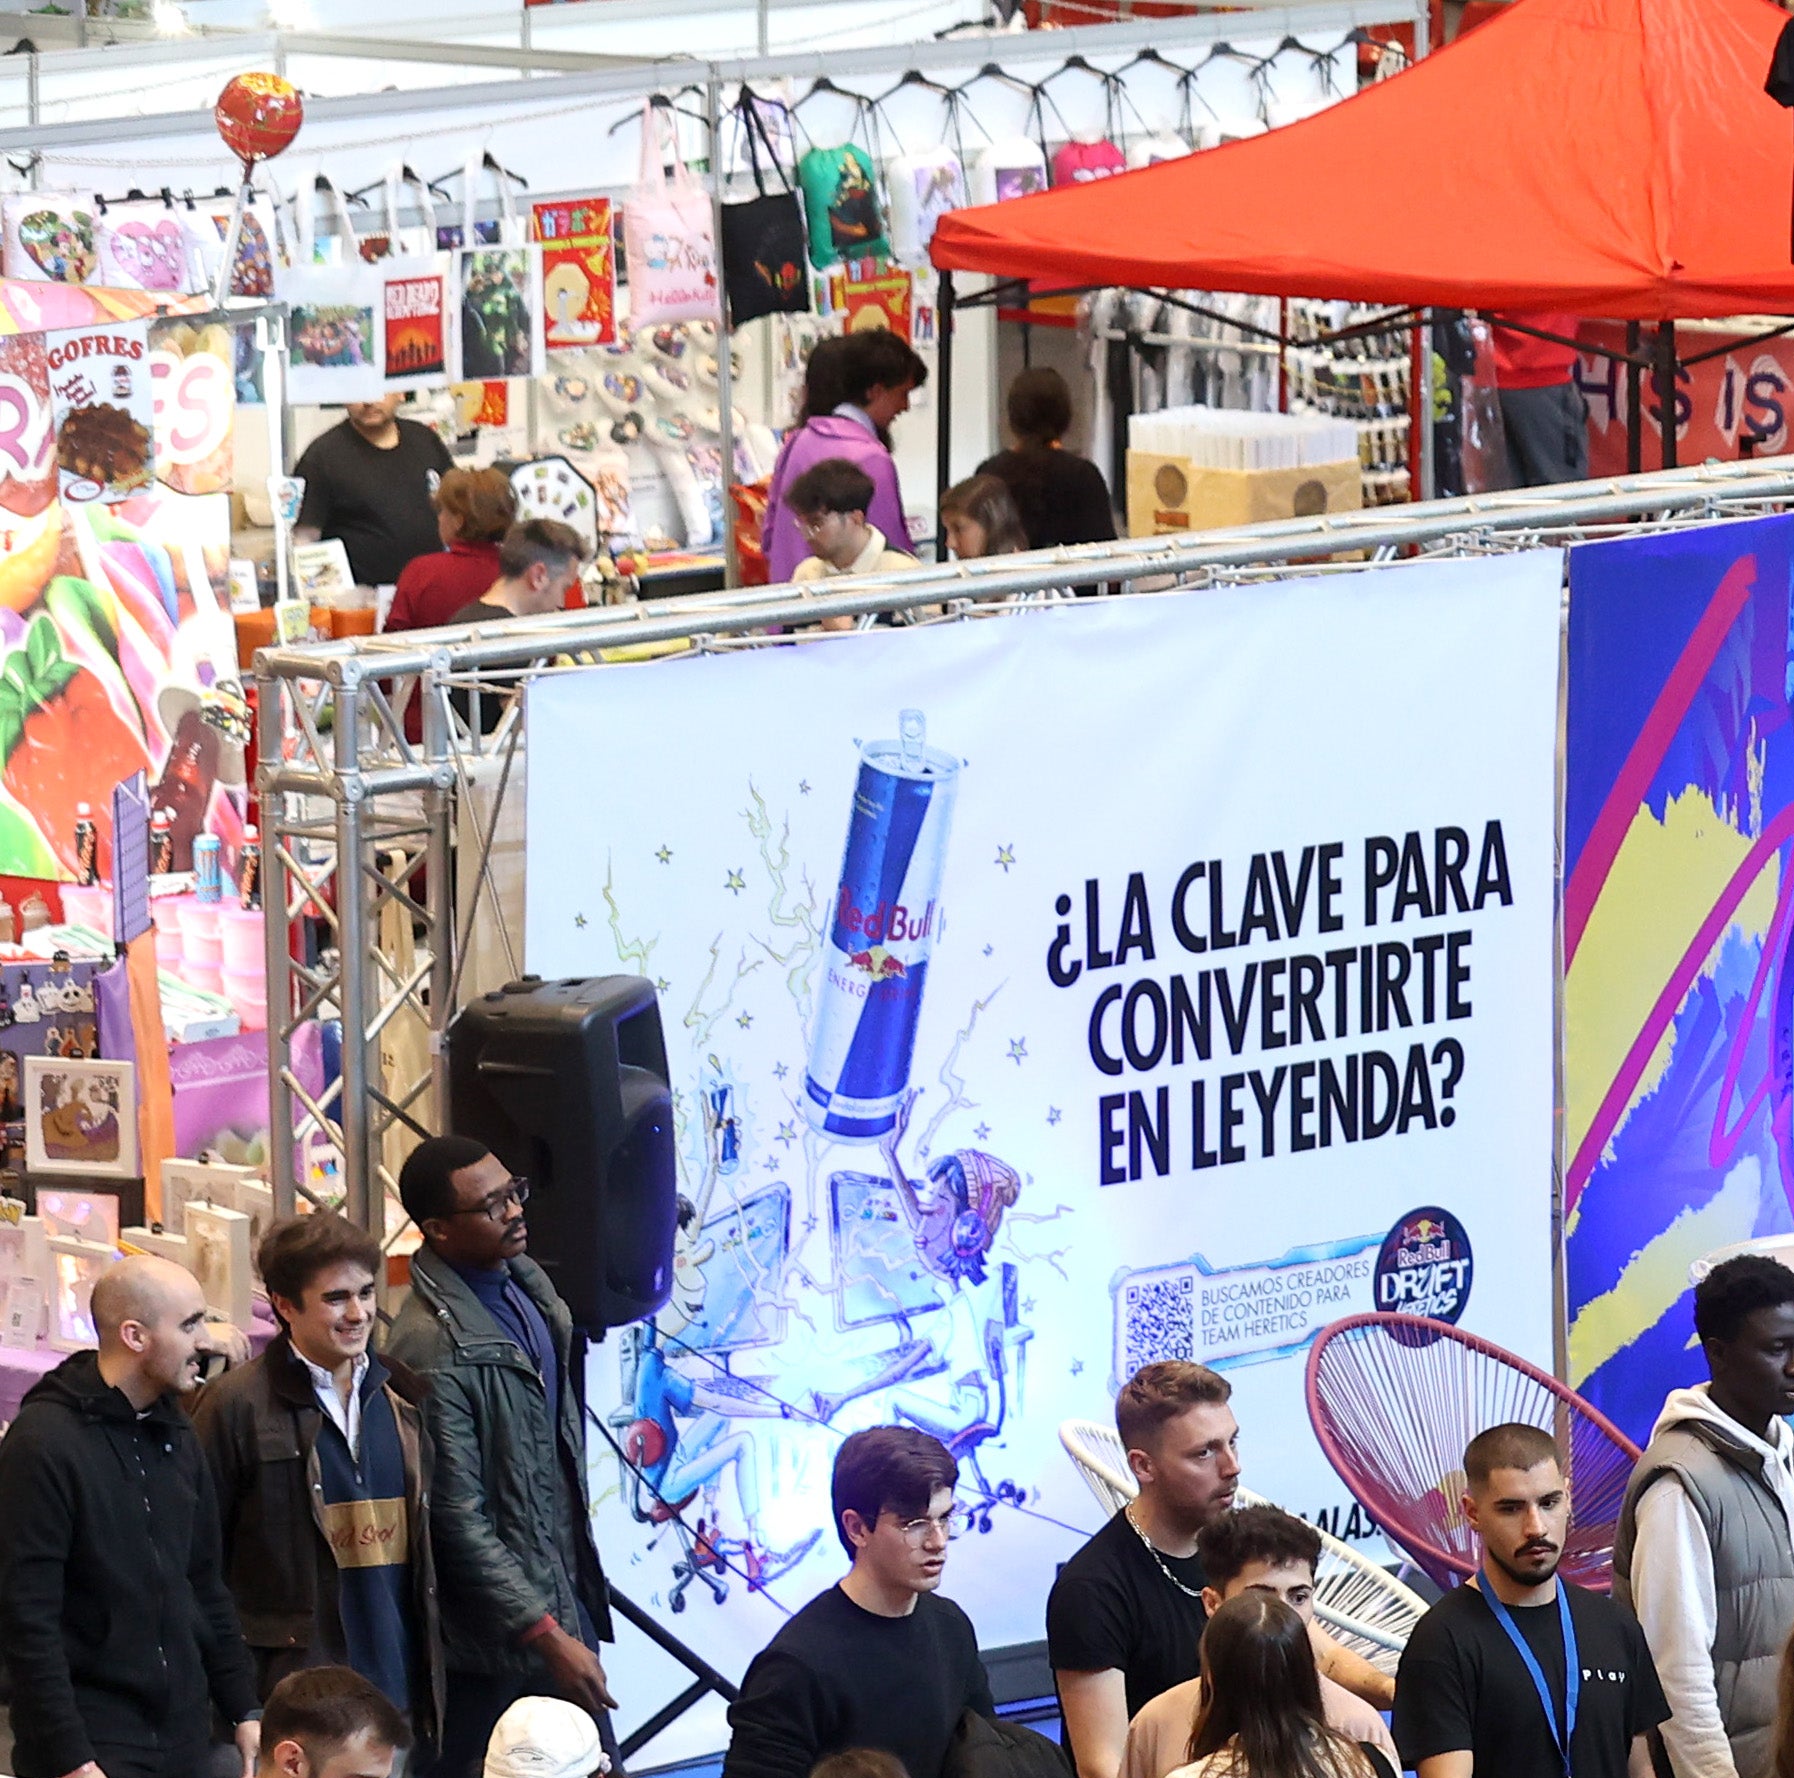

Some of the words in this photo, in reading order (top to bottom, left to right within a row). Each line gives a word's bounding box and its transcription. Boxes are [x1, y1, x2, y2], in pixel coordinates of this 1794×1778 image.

[49, 334, 144, 371] GOFRES
[1724, 367, 1786, 435] IS
[886, 898, 936, 942] Bull
[1047, 871, 1156, 988] ¿LA
[1171, 842, 1344, 954] CLAVE
[1363, 819, 1514, 927] PARA
[1088, 929, 1473, 1076] CONVERTIRTE
[1099, 1085, 1170, 1187] EN
[1191, 1037, 1465, 1171] LEYENDA?
[1398, 1244, 1424, 1266] Red
[1424, 1238, 1451, 1262] Bull
[1201, 1275, 1283, 1307] BUSCAMOS
[1286, 1260, 1370, 1295] CREADORES
[1201, 1307, 1224, 1328] DE
[1227, 1290, 1312, 1322] CONTENIDO
[1316, 1282, 1351, 1304] PARA
[1201, 1325, 1242, 1347] TEAM
[1245, 1313, 1308, 1339] HERETICS
